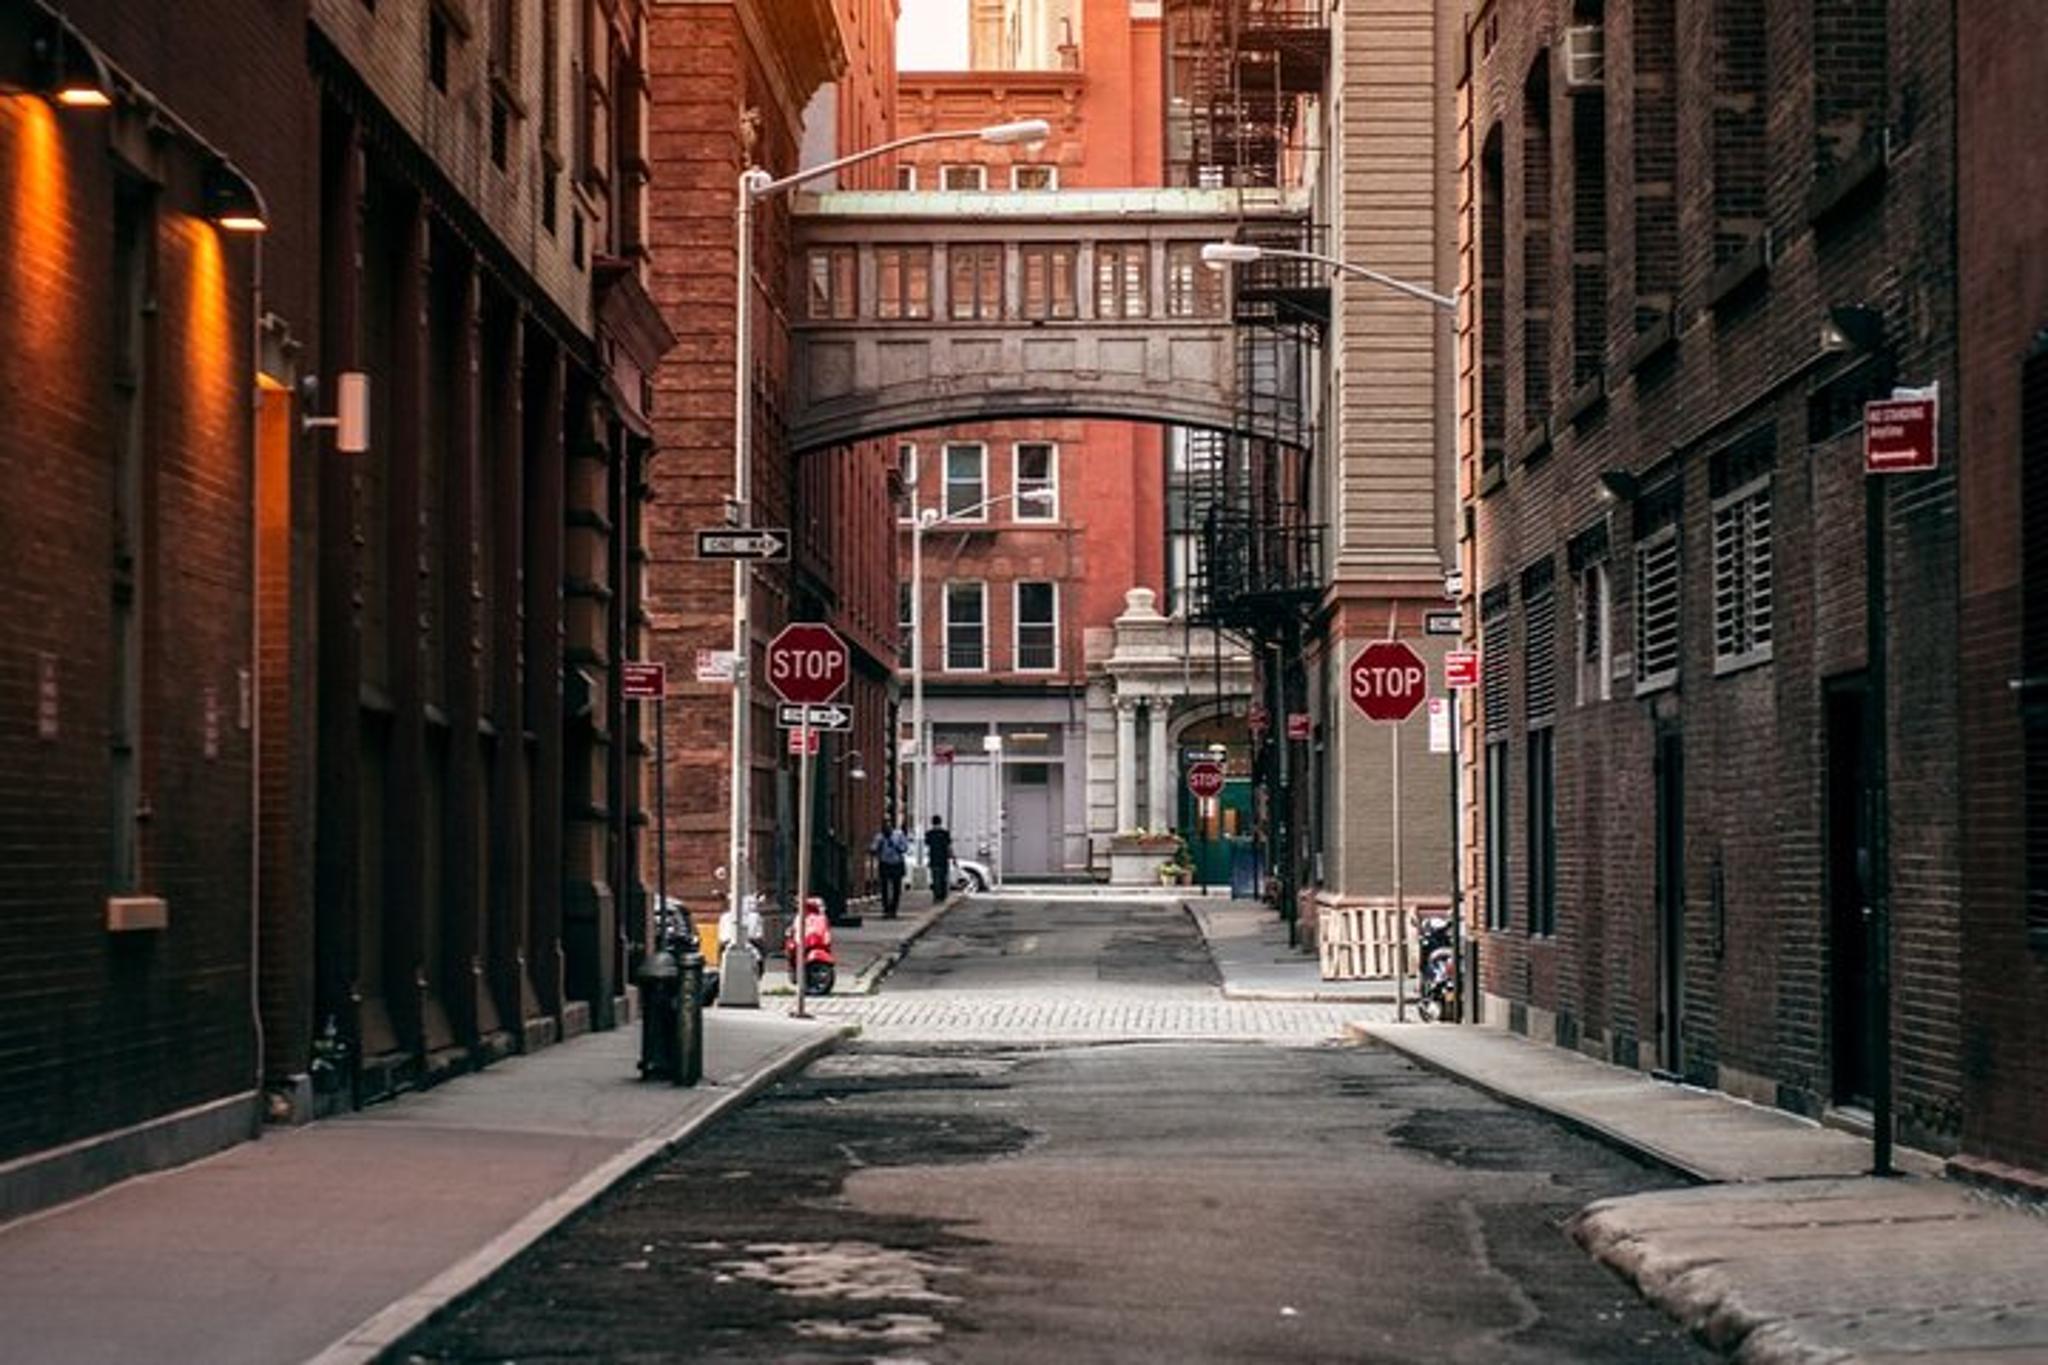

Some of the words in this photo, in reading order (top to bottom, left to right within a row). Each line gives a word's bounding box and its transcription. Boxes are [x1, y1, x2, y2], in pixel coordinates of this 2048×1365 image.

[773, 649, 842, 679] STOP
[1354, 667, 1421, 697] STOP
[1191, 774, 1221, 787] STOP
